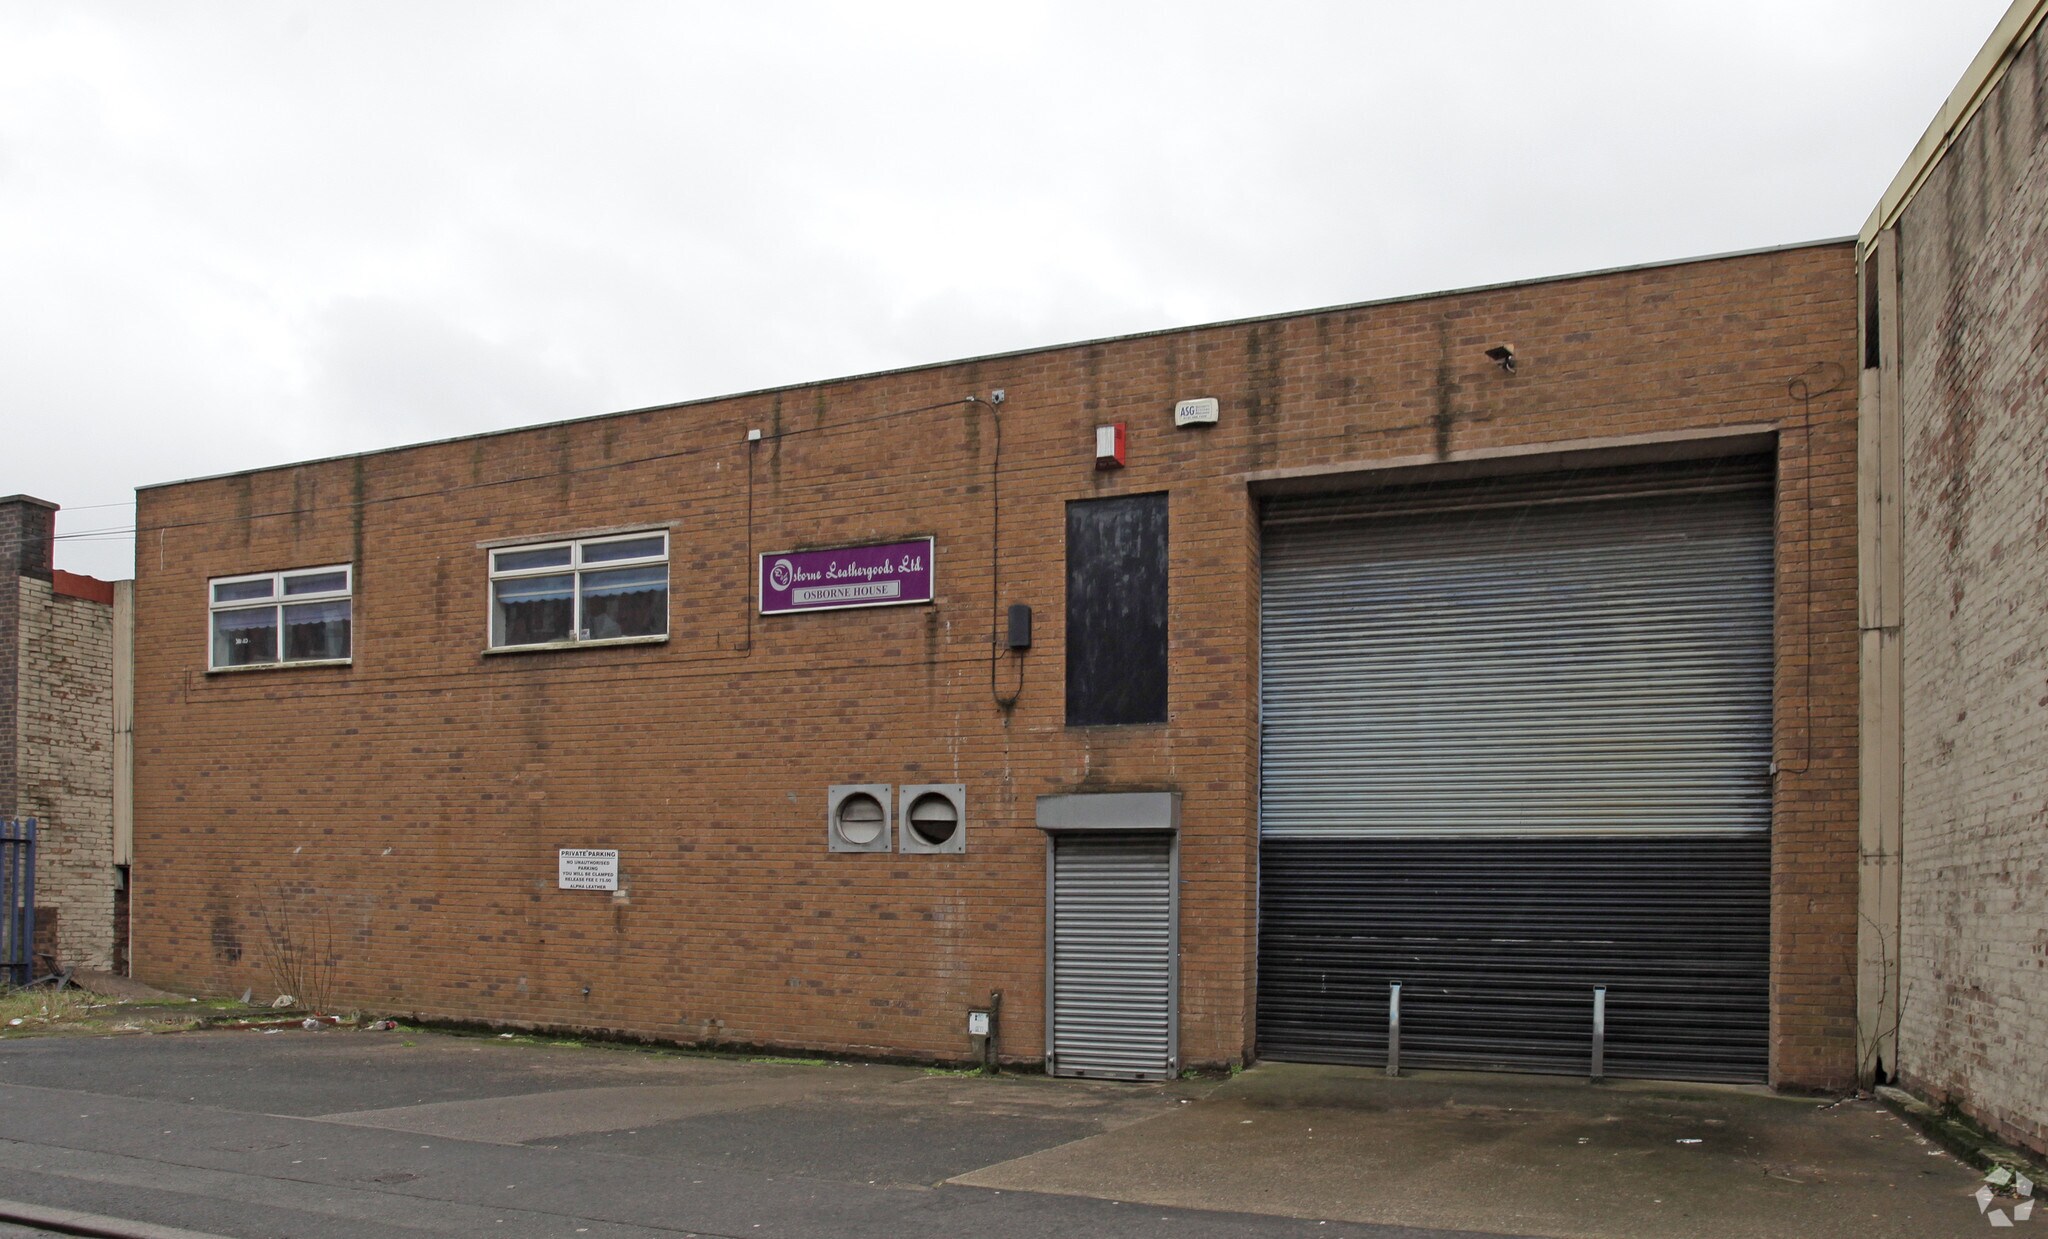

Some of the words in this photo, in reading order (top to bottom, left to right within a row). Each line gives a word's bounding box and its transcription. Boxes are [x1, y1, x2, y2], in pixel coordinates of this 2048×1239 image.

[1180, 405, 1195, 417] ASG
[769, 558, 822, 592] Osborne
[825, 558, 894, 581] Leathergoods
[897, 554, 924, 573] Ltd.
[803, 588, 850, 600] OSBORNE
[853, 585, 889, 597] HOUSE
